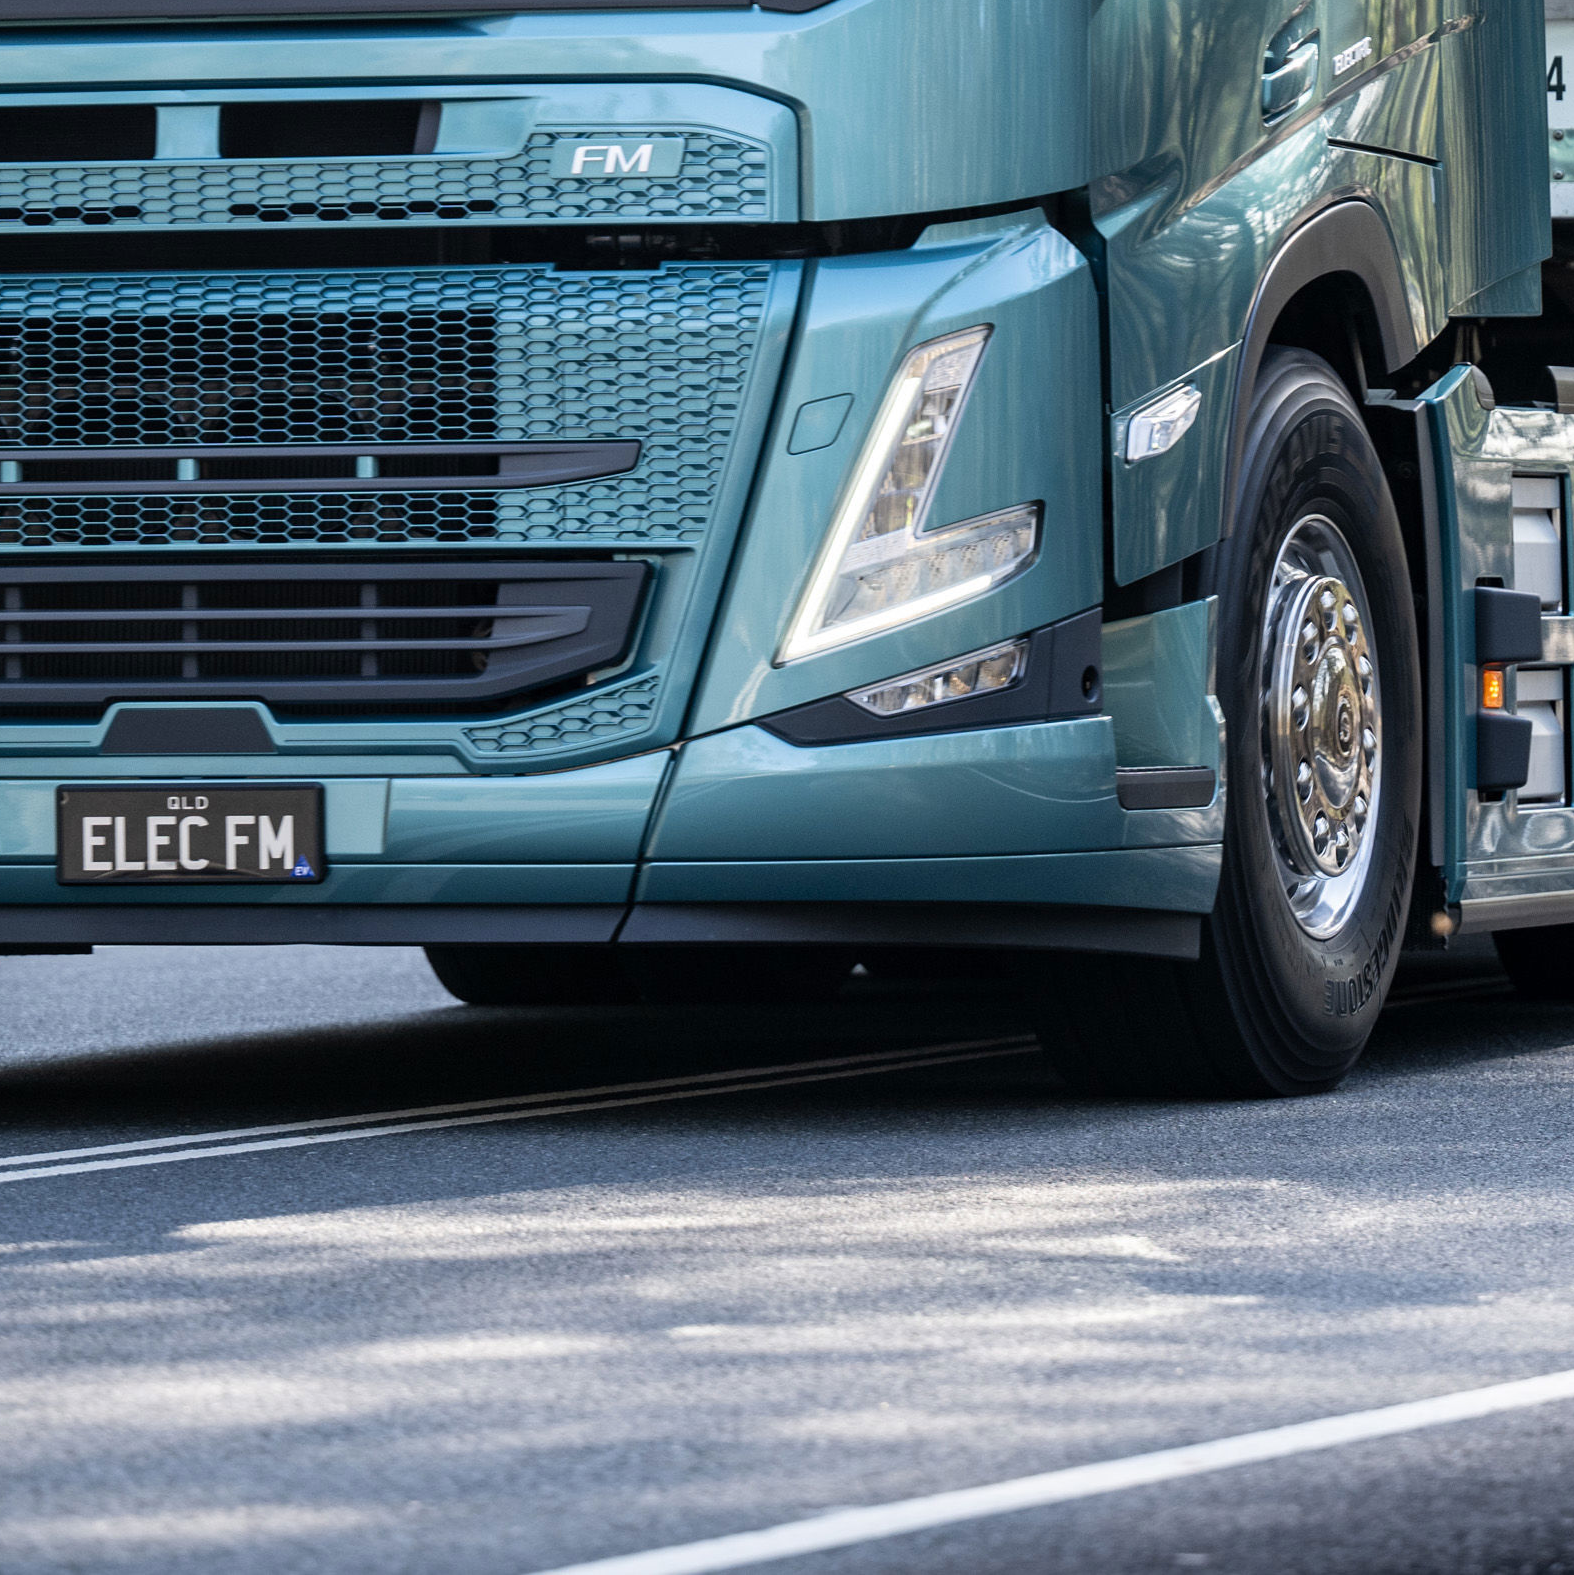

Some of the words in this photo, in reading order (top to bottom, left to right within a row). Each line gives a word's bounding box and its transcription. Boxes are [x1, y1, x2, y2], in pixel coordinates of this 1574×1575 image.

[570, 144, 654, 174] FM
[167, 796, 210, 810] QLD
[82, 815, 210, 871] ELEC
[225, 815, 295, 870] FM
